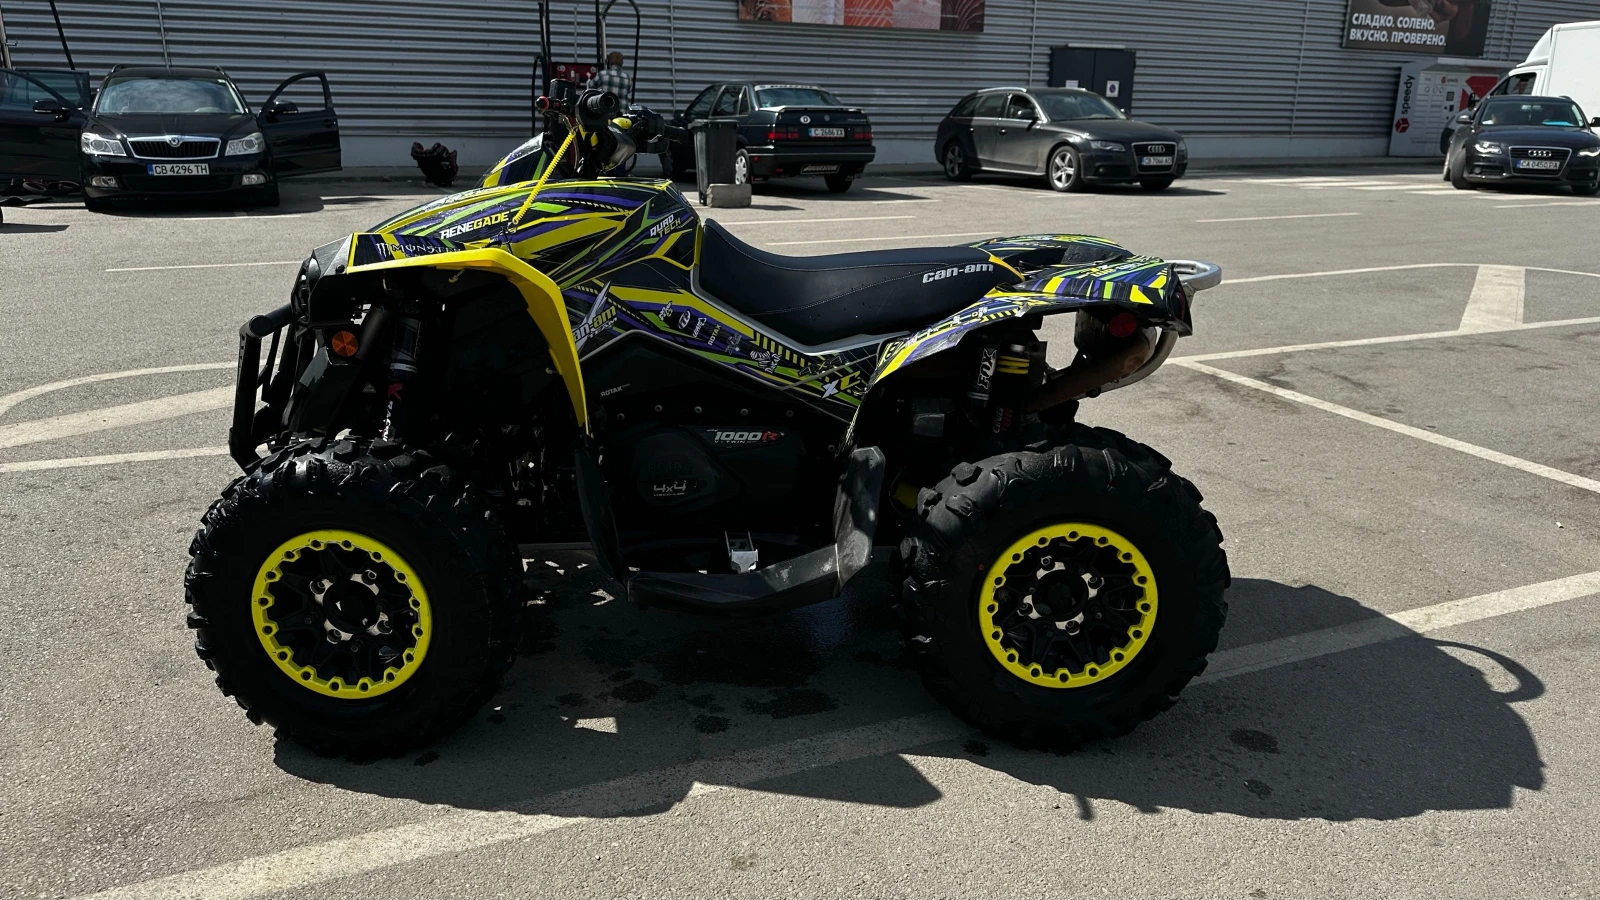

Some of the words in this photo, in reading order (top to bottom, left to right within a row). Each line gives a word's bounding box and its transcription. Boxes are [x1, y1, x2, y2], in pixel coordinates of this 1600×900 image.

[1352, 13, 1394, 28] СЛАДКО.
[1396, 16, 1436, 30] СОЛЕНО.
[1350, 29, 1389, 42] ВКУСНО.
[1391, 31, 1447, 46] ПРОВЕРЕНО.
[1401, 75, 1415, 115] speedy
[154, 165, 168, 175] CB
[169, 165, 193, 175] 4296
[194, 165, 208, 174] TH
[440, 211, 510, 239] RENEGADE
[649, 214, 674, 236] QUAD
[658, 217, 681, 237] TECH
[922, 263, 994, 284] can-am
[572, 305, 617, 341] an-am
[707, 324, 722, 346] ROTAX
[977, 347, 997, 389] FOX
[600, 386, 623, 397] ROTAX
